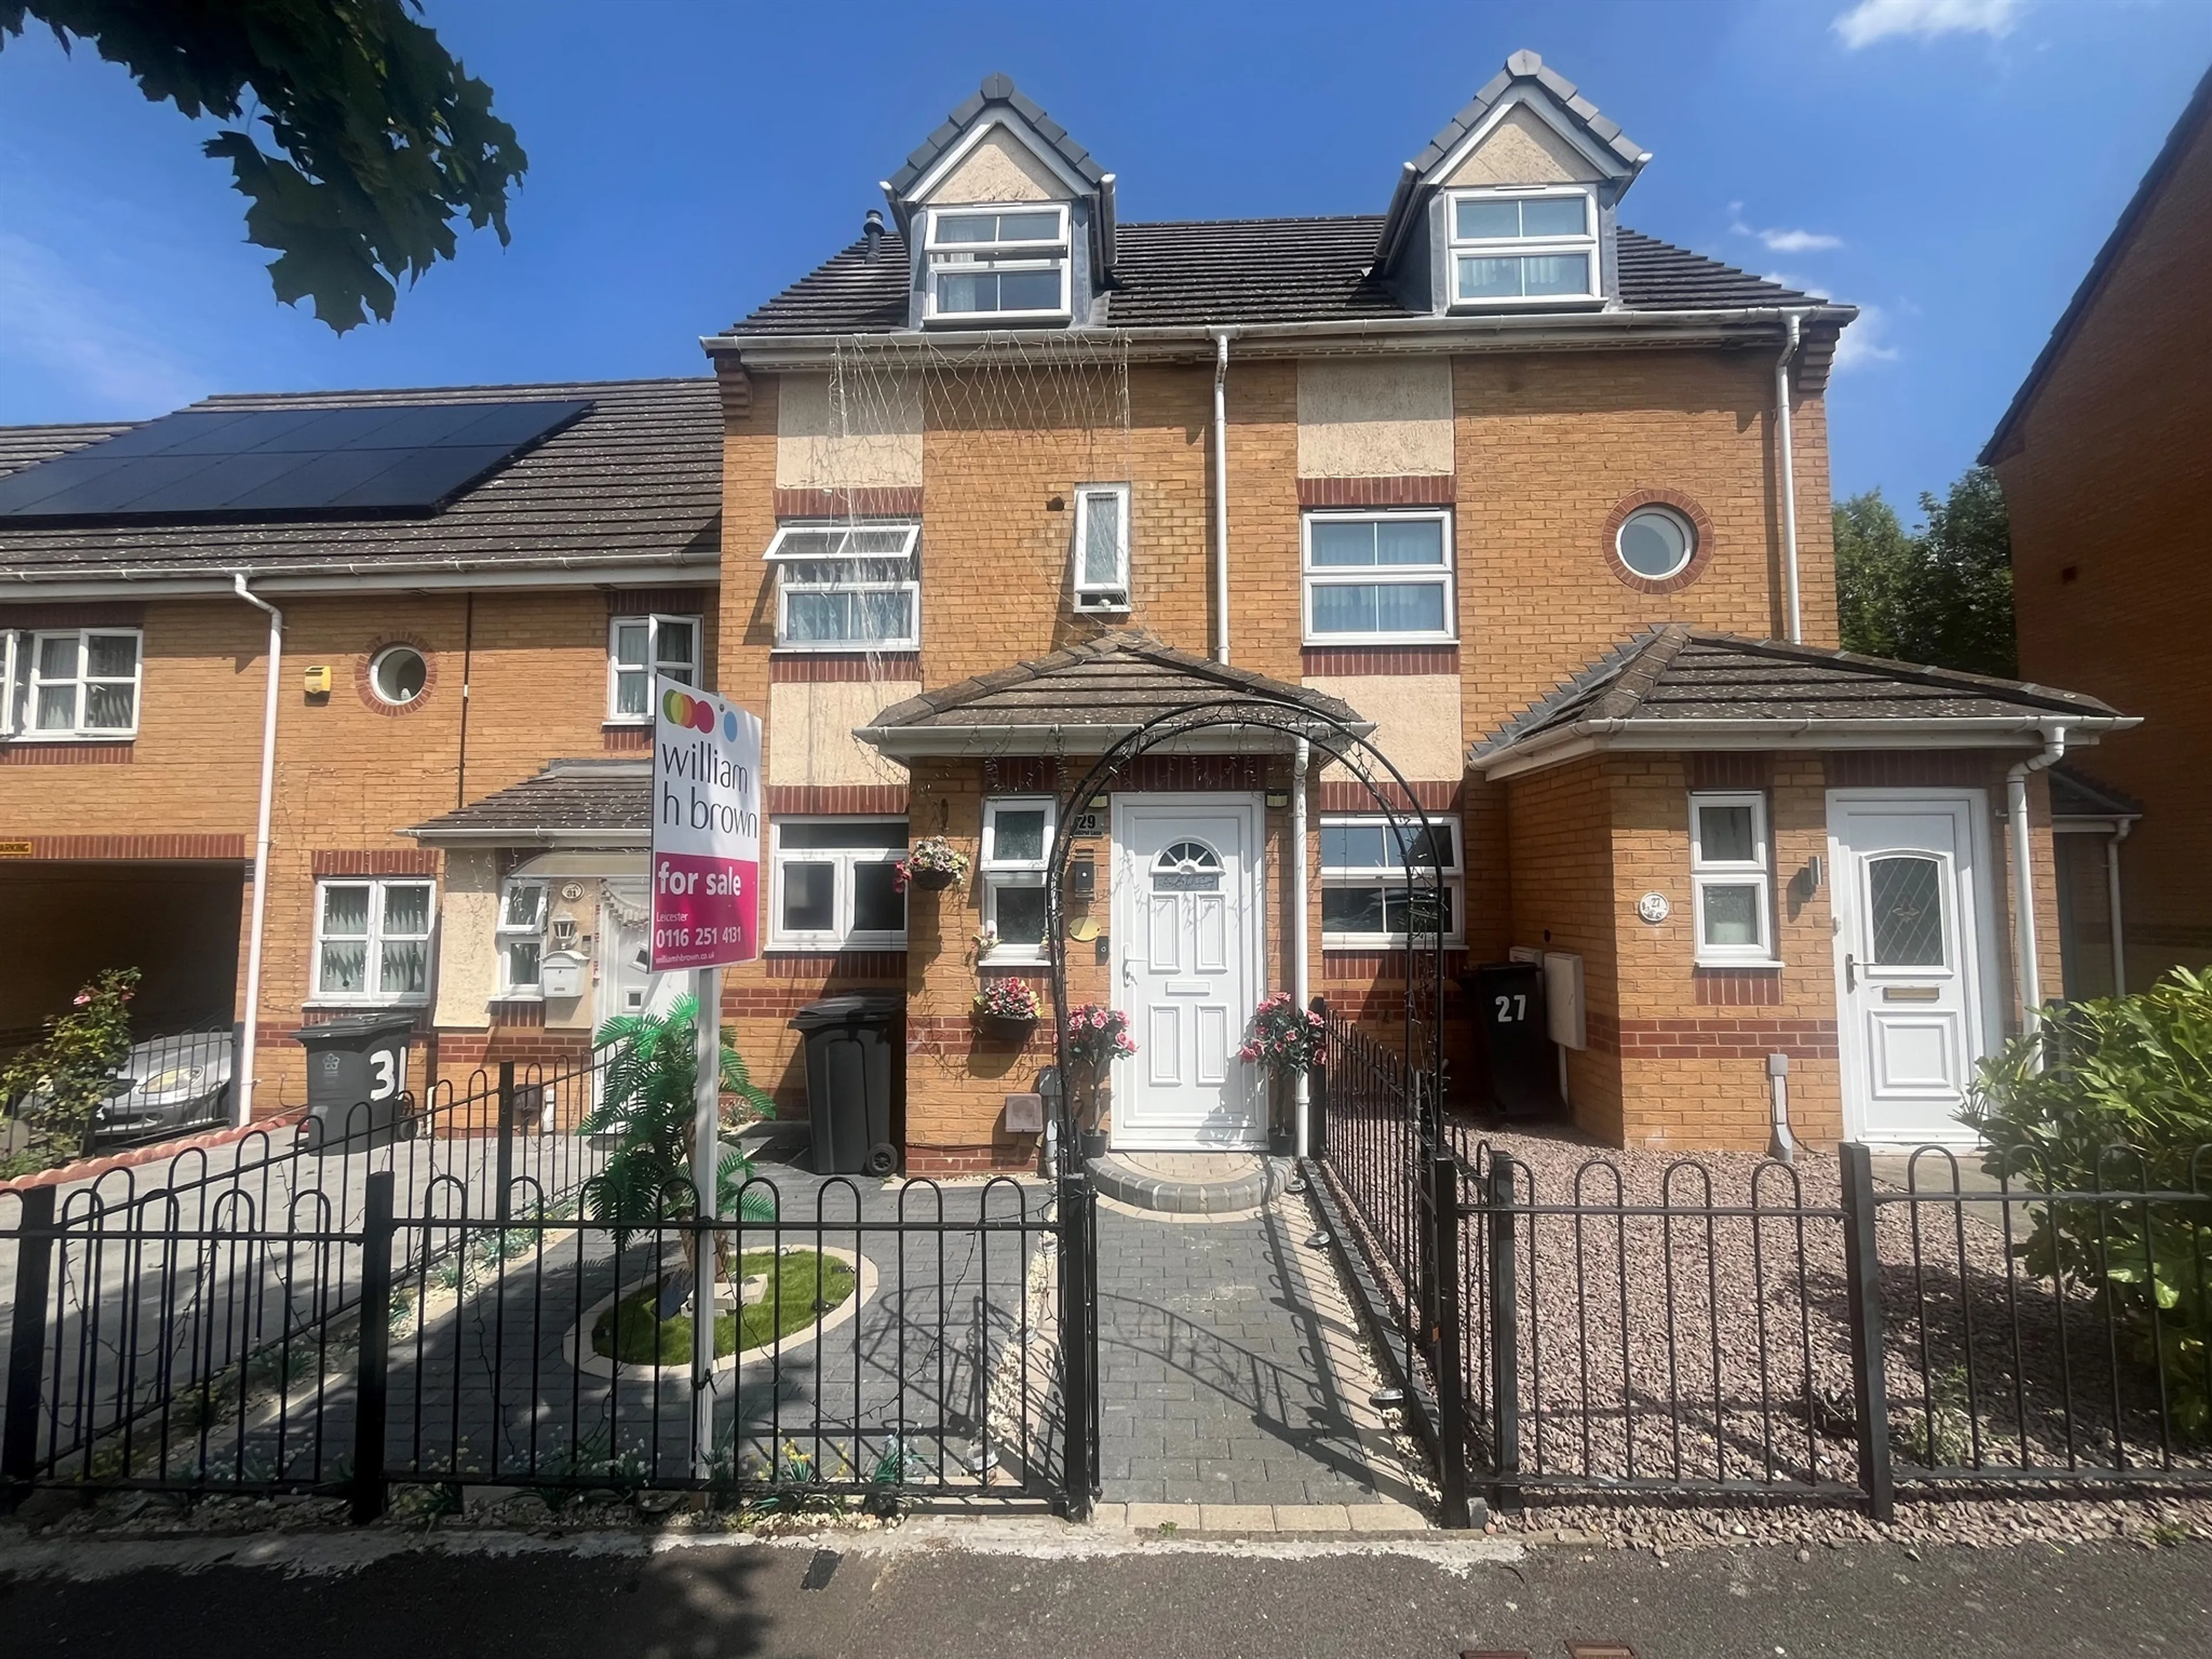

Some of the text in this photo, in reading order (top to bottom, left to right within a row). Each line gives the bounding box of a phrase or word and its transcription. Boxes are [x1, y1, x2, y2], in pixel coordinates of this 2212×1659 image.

[662, 741, 747, 794] william
[664, 781, 757, 839] h brown
[1077, 814, 1096, 829] 29
[658, 861, 741, 896] for sale
[1652, 897, 1660, 908] 27
[656, 911, 688, 922] Leicester
[656, 926, 741, 948] 0116 251 4131
[1495, 995, 1526, 1022] 27
